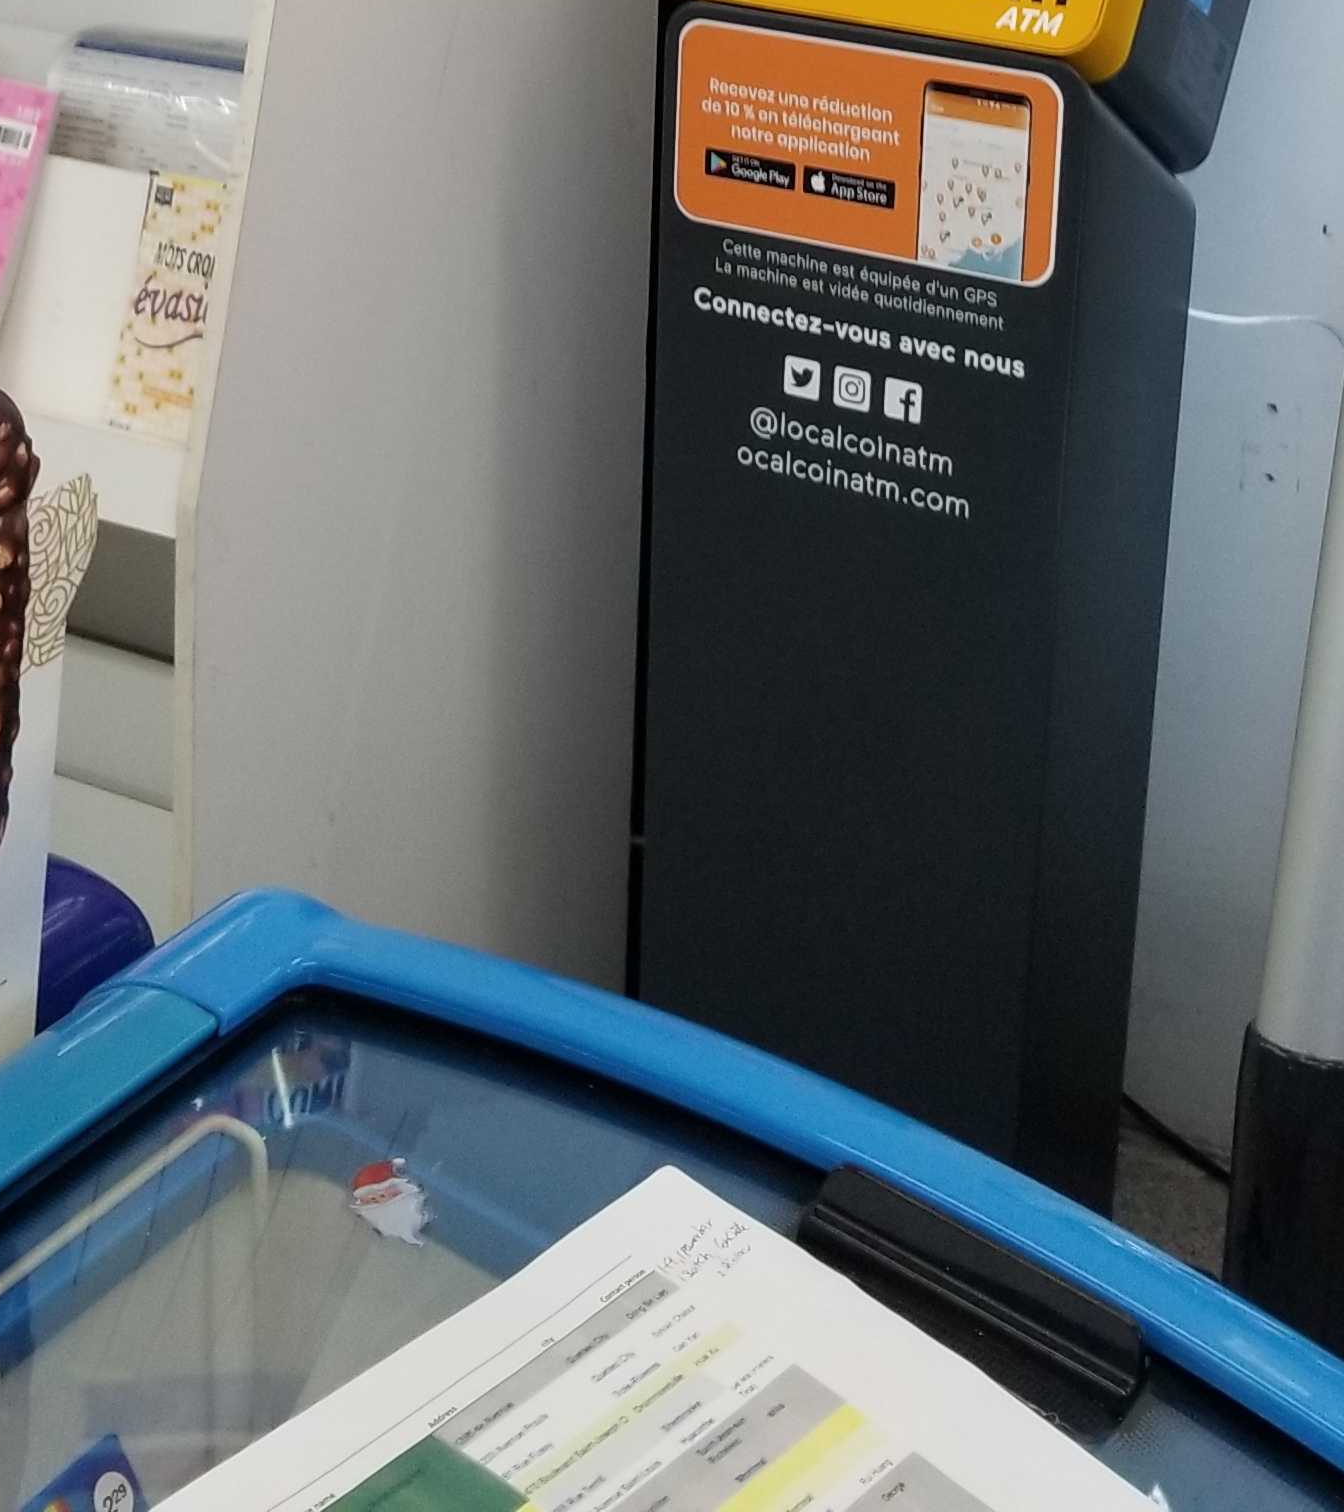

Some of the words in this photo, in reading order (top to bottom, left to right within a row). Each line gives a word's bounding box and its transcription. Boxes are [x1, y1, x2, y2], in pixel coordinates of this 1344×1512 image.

[994, 5, 1065, 38] ATM
[702, 97, 722, 114] de
[725, 100, 740, 117] 10
[744, 103, 755, 120] %
[758, 108, 779, 124] en
[782, 111, 900, 146] téléchargeant
[710, 77, 775, 104] Recevez
[778, 91, 809, 109] une
[812, 95, 893, 124] réduction
[731, 125, 774, 144] notre
[777, 132, 871, 162] application
[731, 162, 768, 183] Google
[769, 169, 791, 188] Play
[831, 182, 855, 201] App
[856, 187, 888, 207] Store
[715, 256, 732, 275] La
[736, 262, 798, 288] machine
[802, 277, 824, 292] est
[829, 281, 869, 302] vidée
[874, 291, 1005, 332] quotidiennement
[722, 238, 761, 259] Cette
[766, 247, 828, 274] machine
[833, 262, 855, 279] est
[860, 267, 920, 294] équipée
[926, 278, 959, 301] d'un
[964, 287, 998, 308] GPS
[133, 274, 209, 324] évasi
[693, 286, 892, 351] Connectez-vous
[899, 333, 956, 364] avec
[963, 345, 1027, 379] nous
[750, 406, 954, 477] @localcoinatm
[736, 444, 971, 520] ocalcoinatm.com
[428, 1406, 458, 1429] Address
